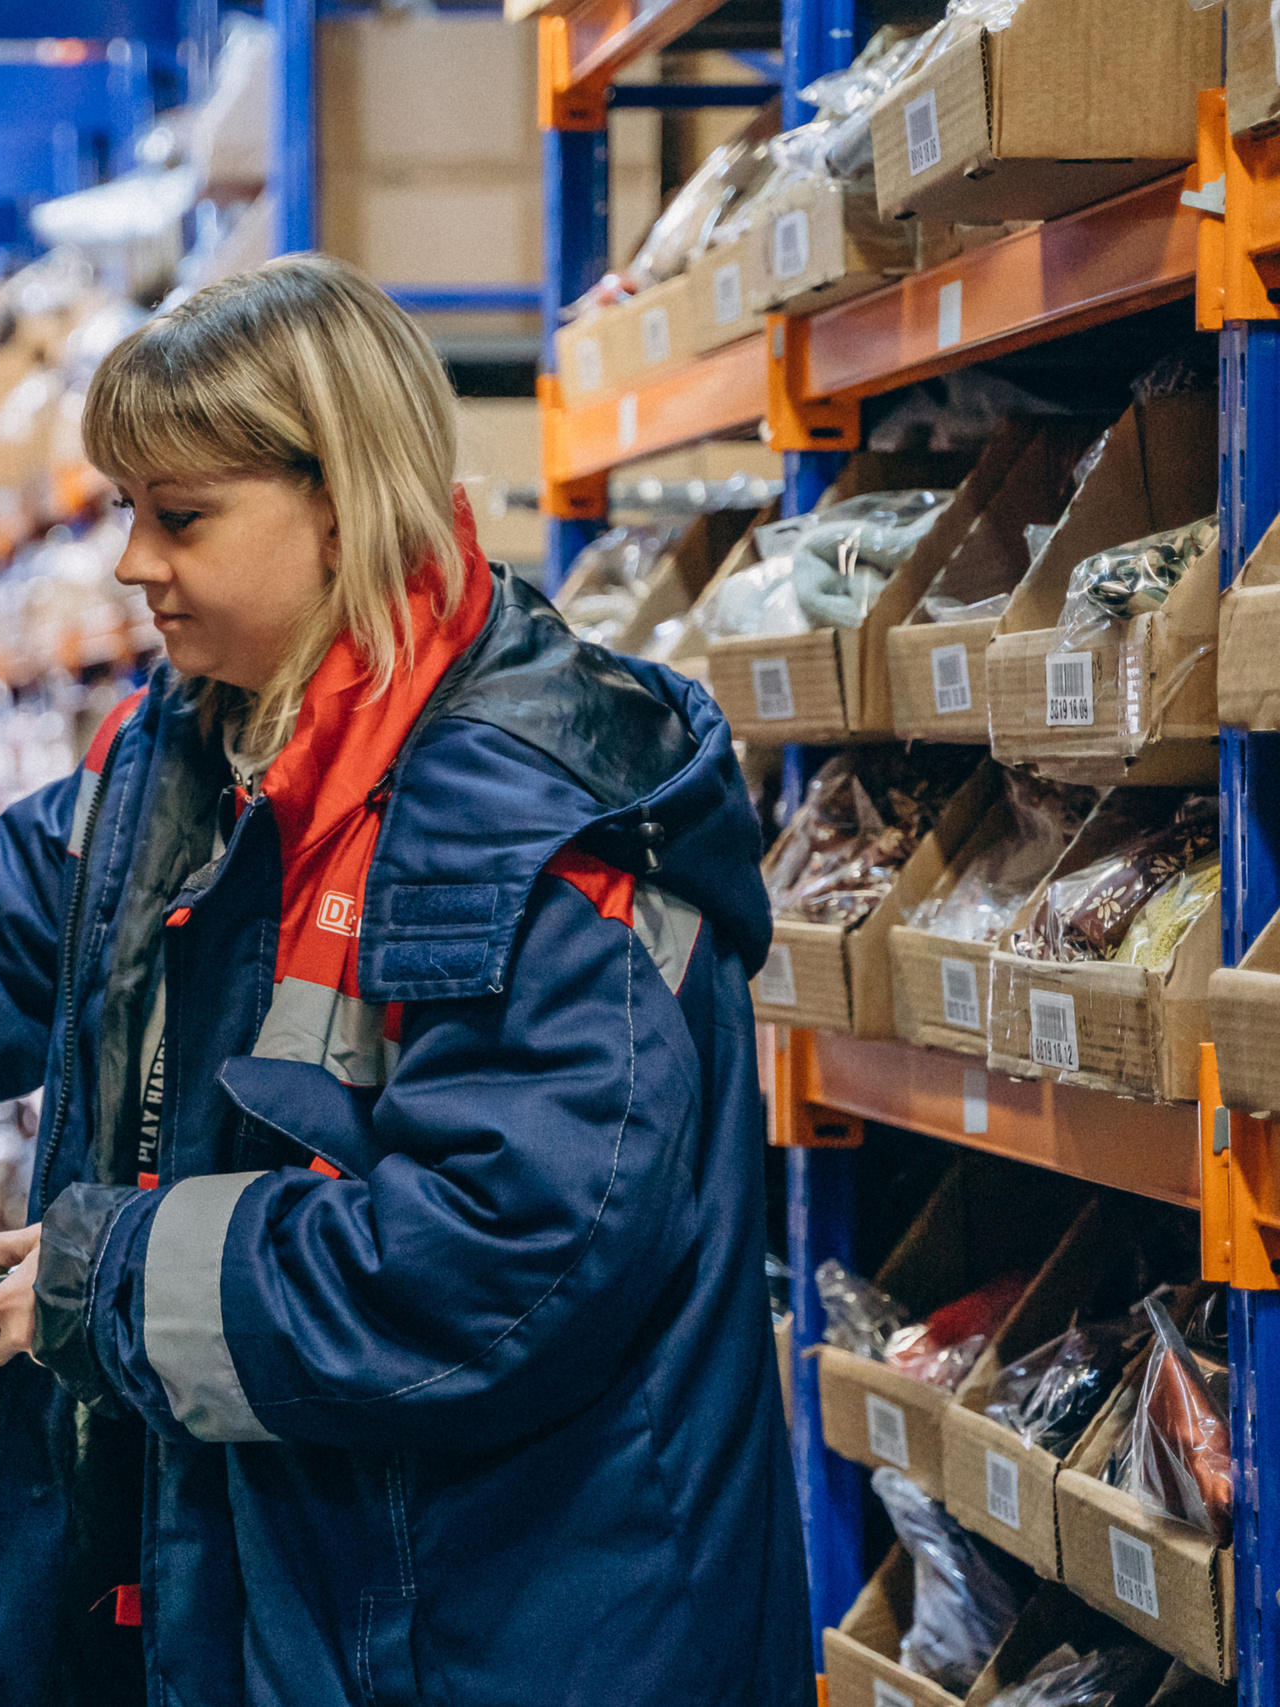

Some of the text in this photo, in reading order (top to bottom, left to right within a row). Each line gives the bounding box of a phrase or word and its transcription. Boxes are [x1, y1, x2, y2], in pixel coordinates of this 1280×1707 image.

[1050, 698, 1068, 720] 8819
[1079, 698, 1089, 720] 09
[1035, 1038, 1053, 1061] 8819
[1063, 1044, 1074, 1066] 12
[137, 1108, 160, 1163] PLAY
